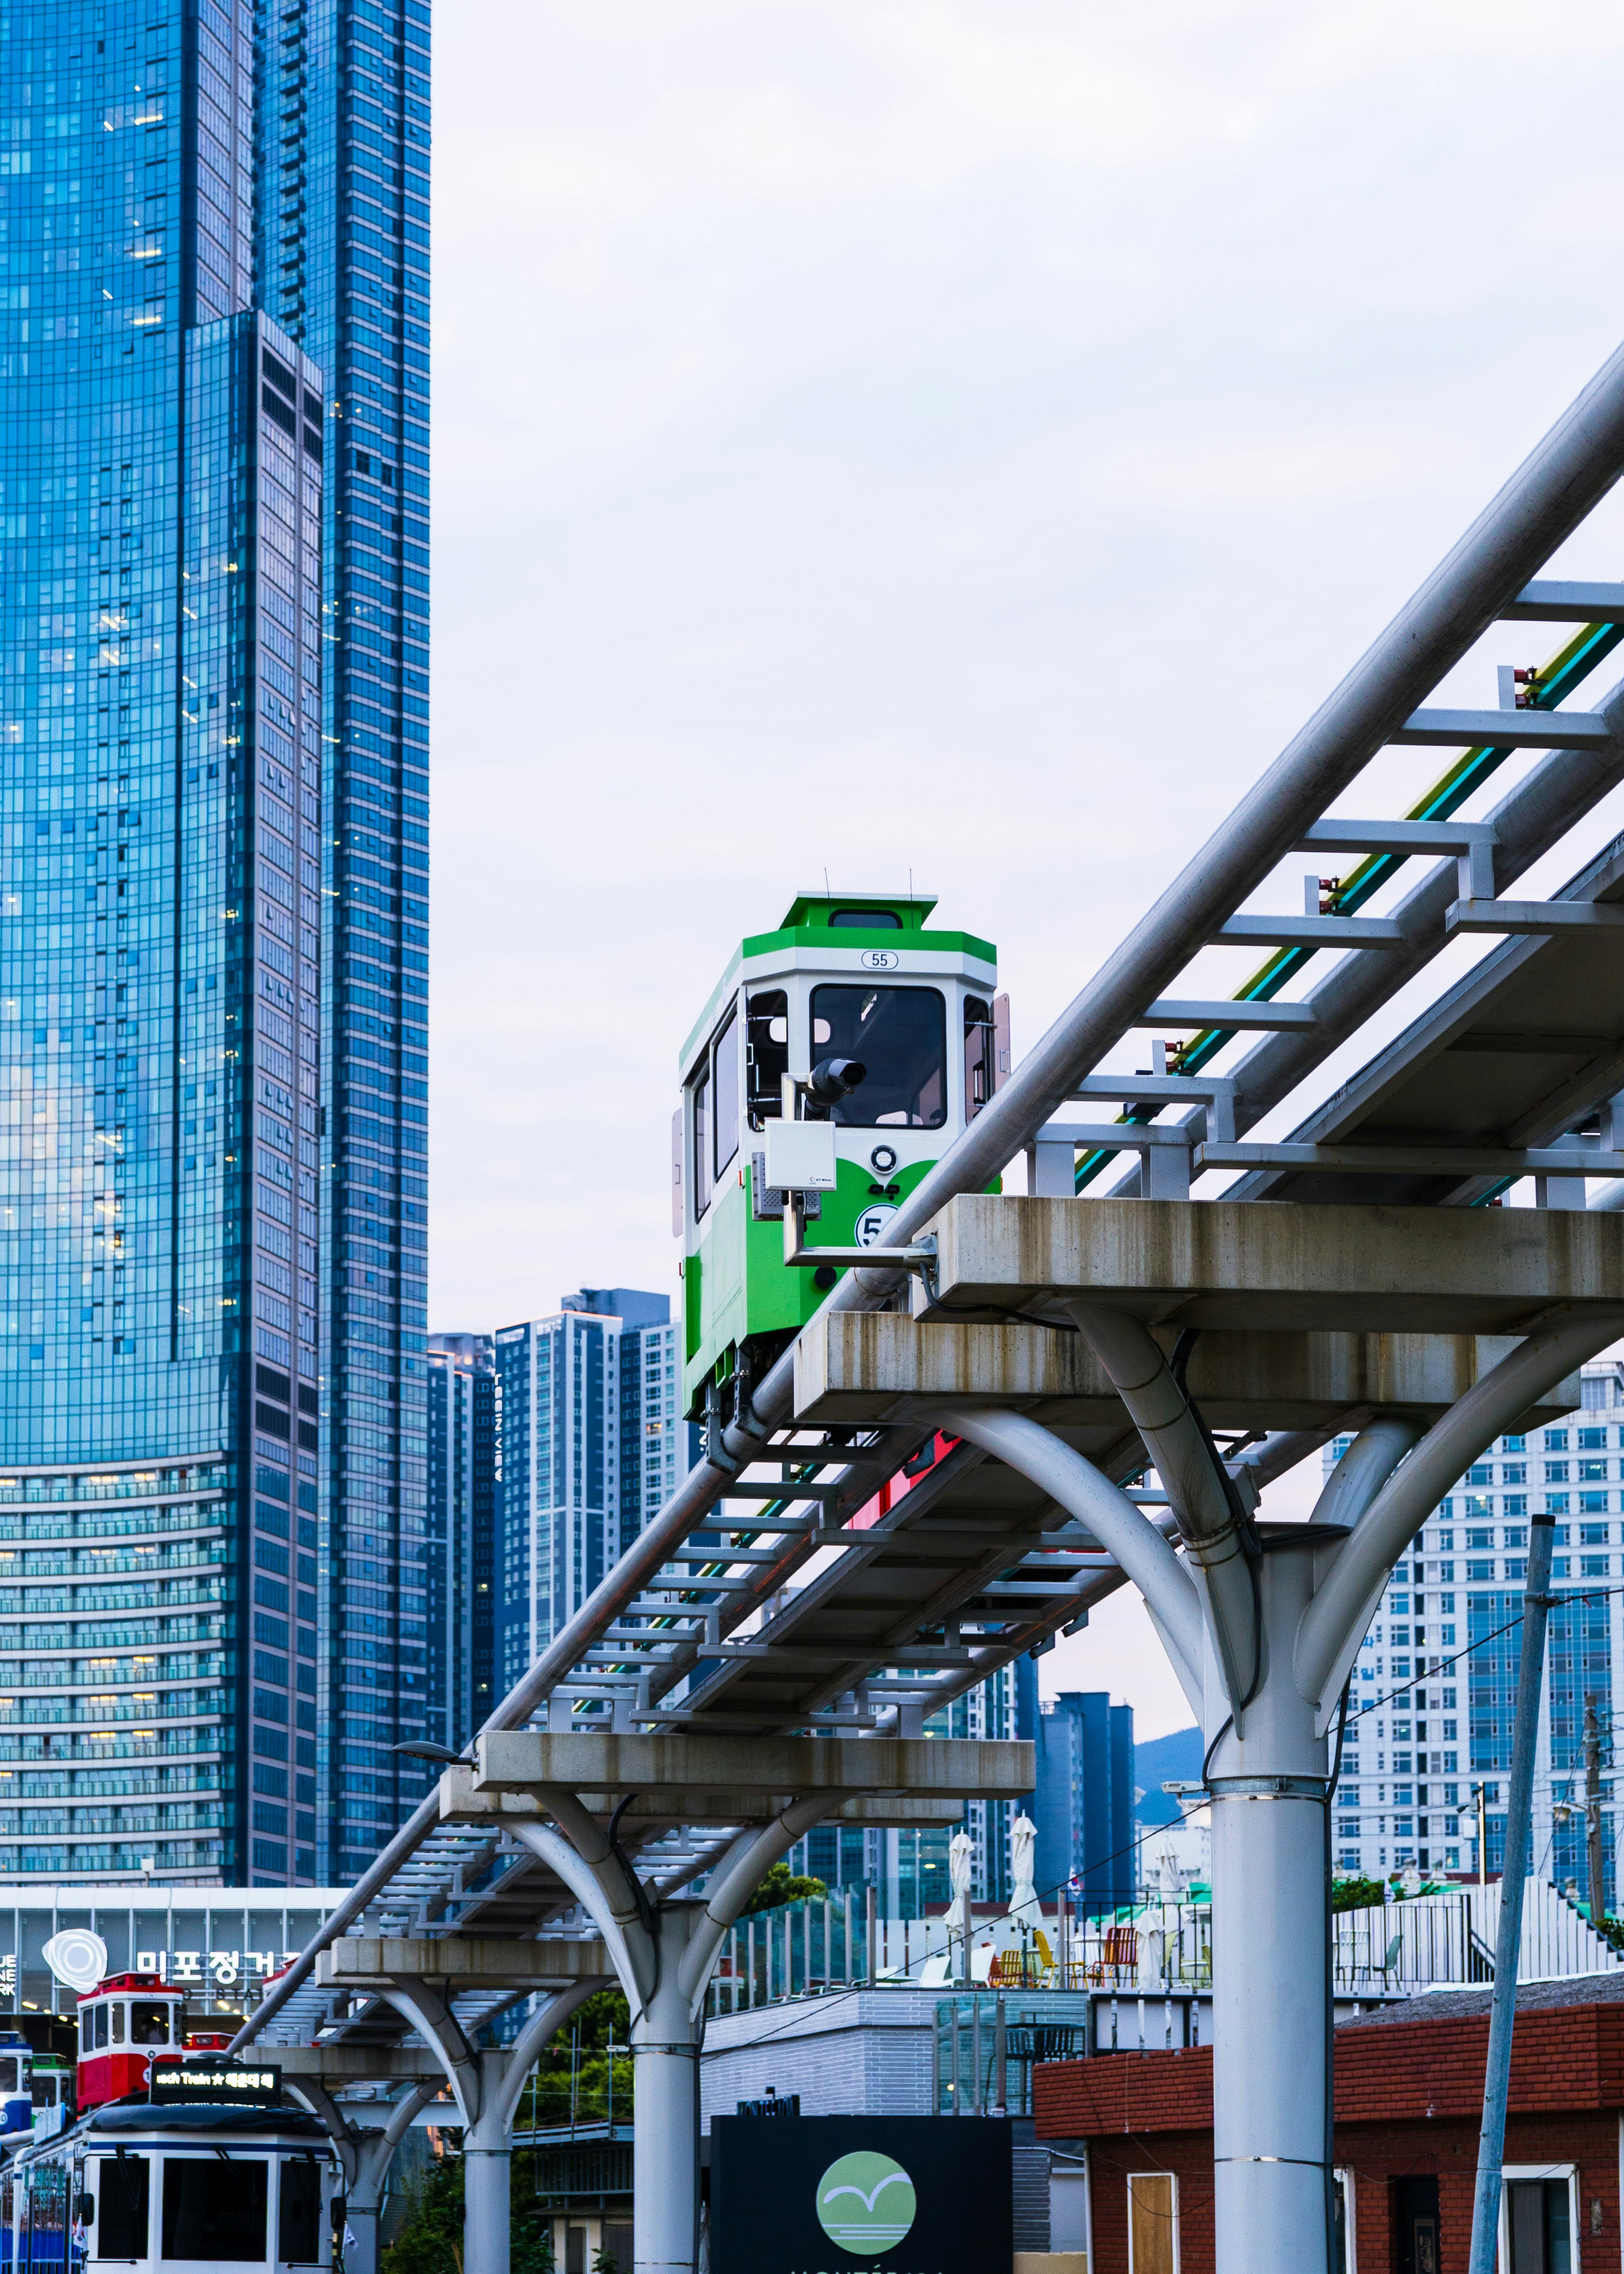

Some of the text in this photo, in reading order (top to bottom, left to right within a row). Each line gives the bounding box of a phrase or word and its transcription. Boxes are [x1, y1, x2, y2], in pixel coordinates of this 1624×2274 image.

[872, 954, 888, 966] 55
[863, 1218, 881, 1246] 5
[0, 1955, 16, 1968] UE
[0, 1983, 16, 1996] RK
